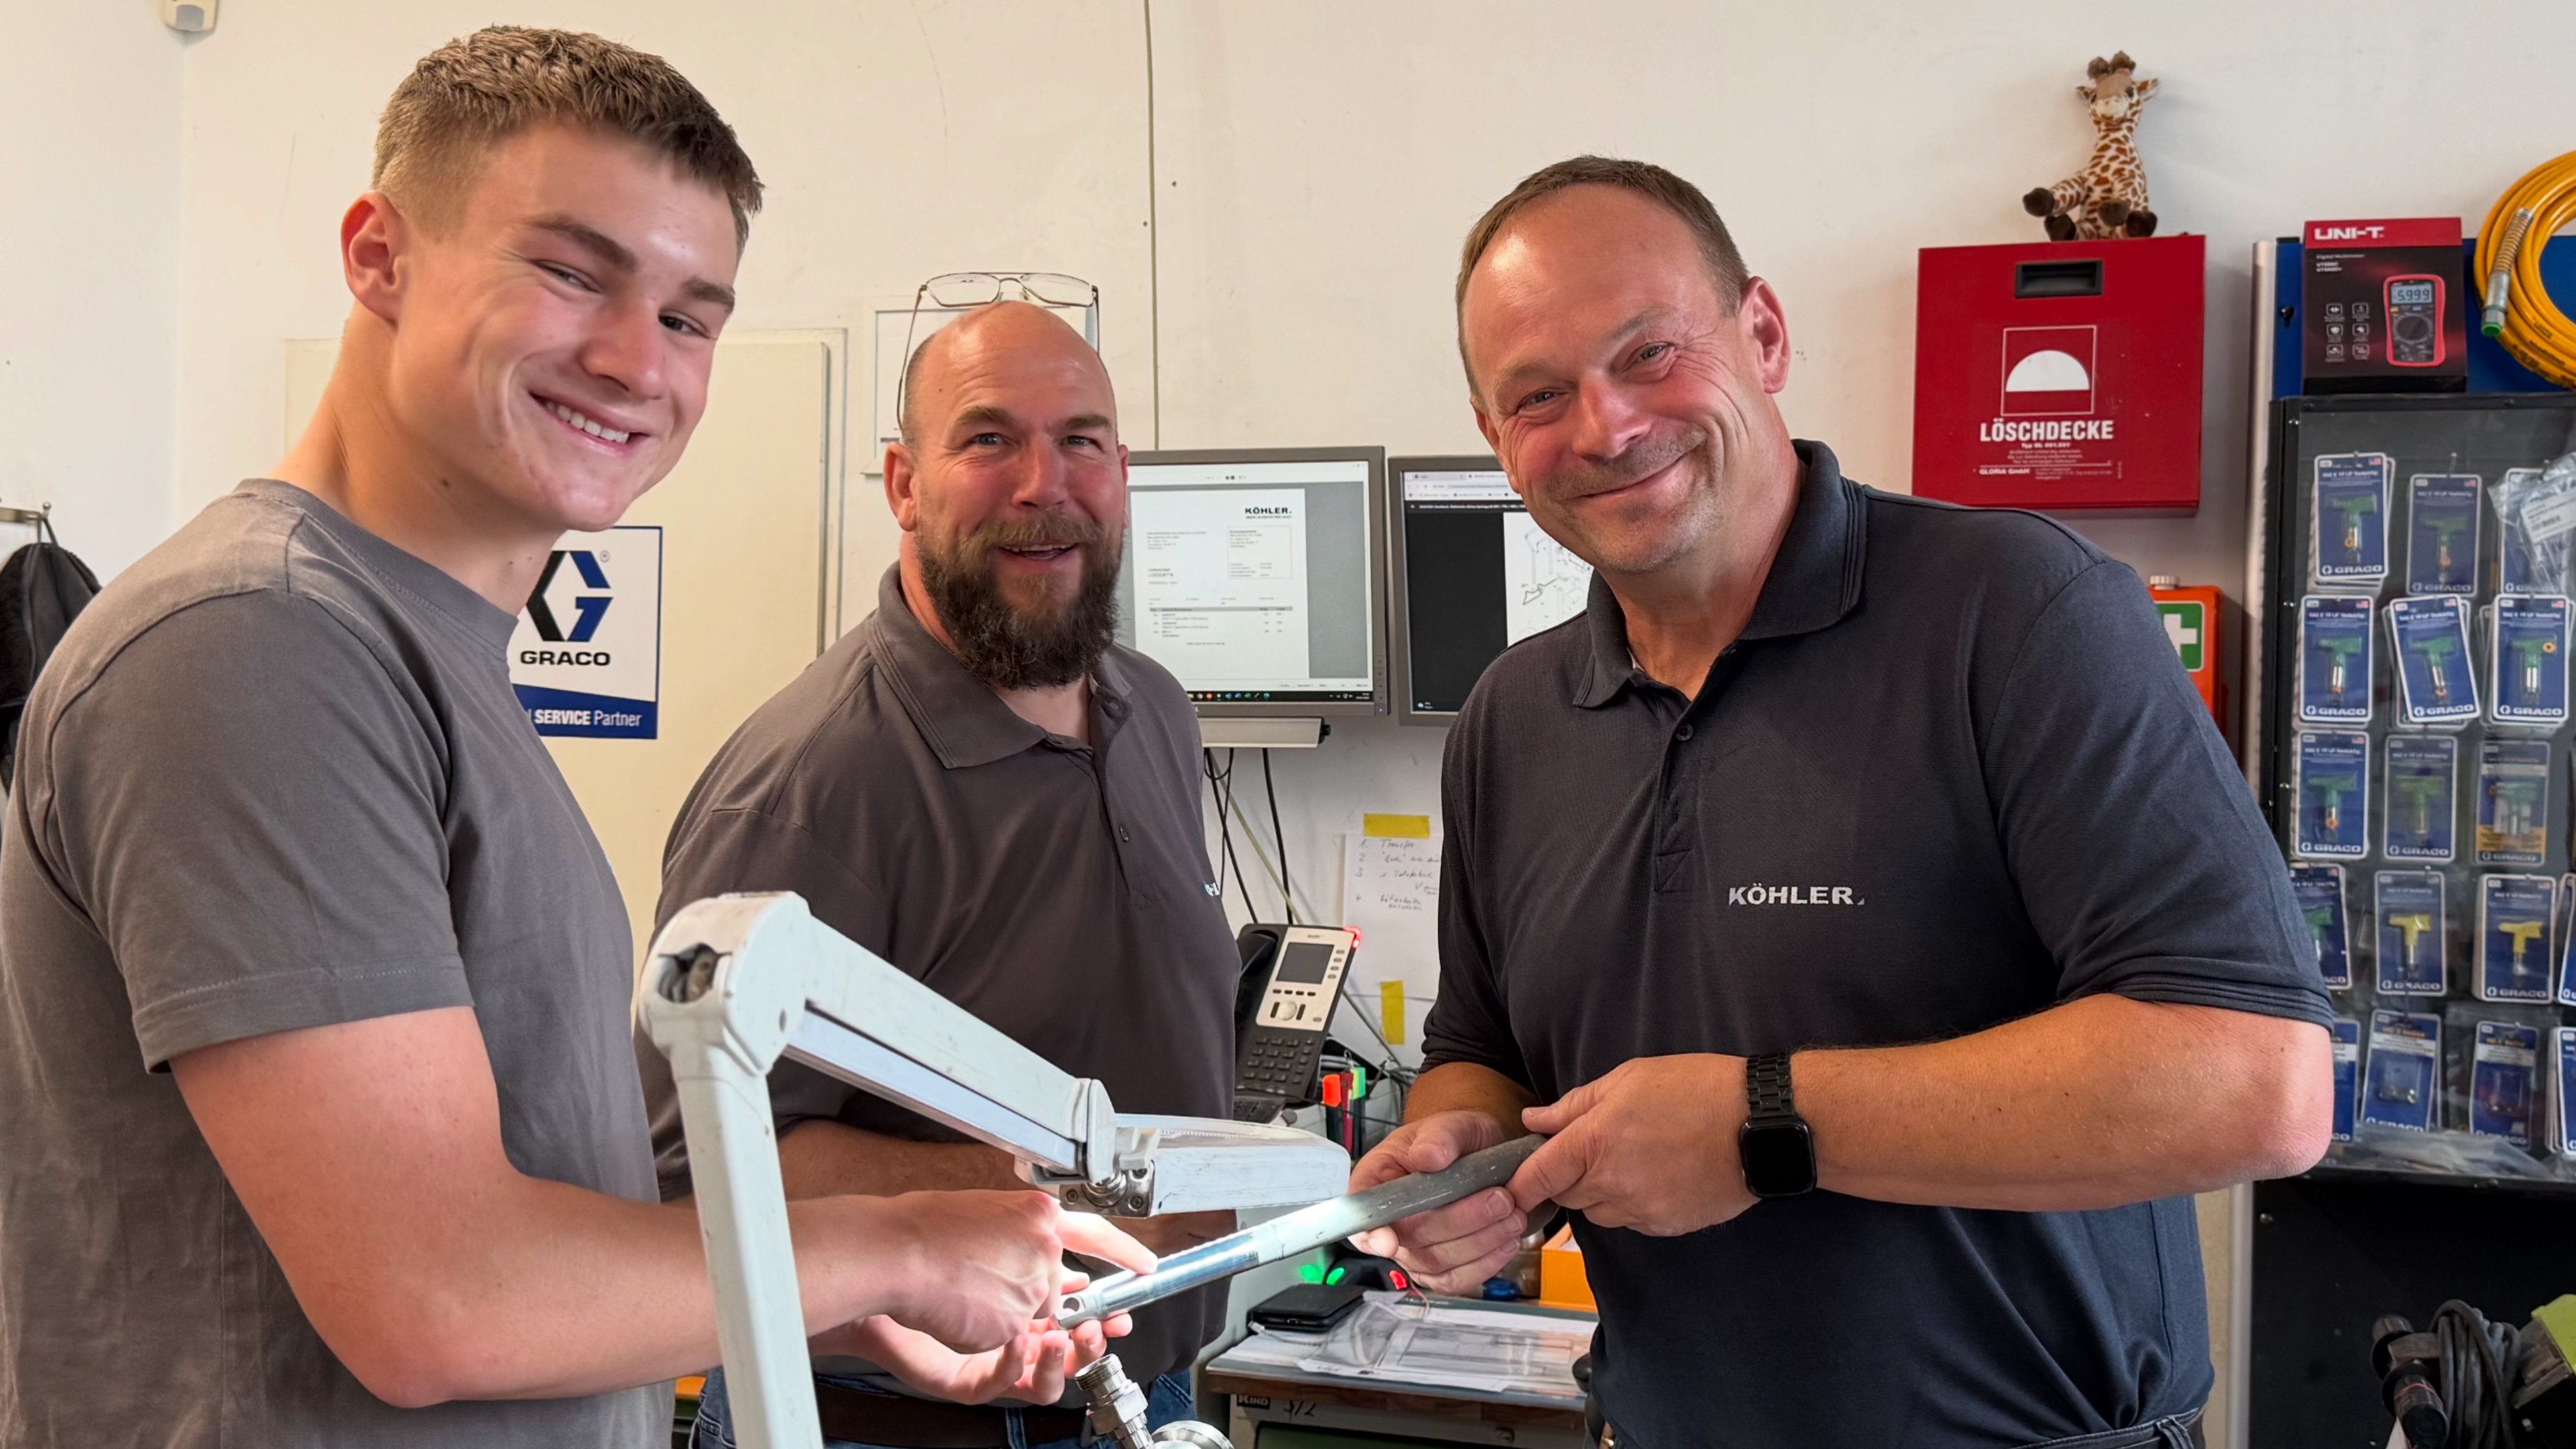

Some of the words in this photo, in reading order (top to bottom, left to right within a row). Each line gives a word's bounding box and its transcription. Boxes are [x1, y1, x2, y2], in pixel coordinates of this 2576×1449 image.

[1980, 418, 2114, 441] LÖSCHDECKE
[2334, 565, 2382, 574] GRACO
[2424, 584, 2471, 592] GRACO
[520, 650, 611, 666] GRACO
[2318, 708, 2367, 716] GRACO
[2426, 705, 2474, 716] GRACO
[2515, 708, 2563, 716] GRACO
[535, 708, 591, 725] SERVICE
[594, 709, 643, 727] Partner
[2314, 844, 2362, 853] GRACO
[2402, 848, 2448, 856] GRACO
[2499, 989, 2546, 998] GRACO
